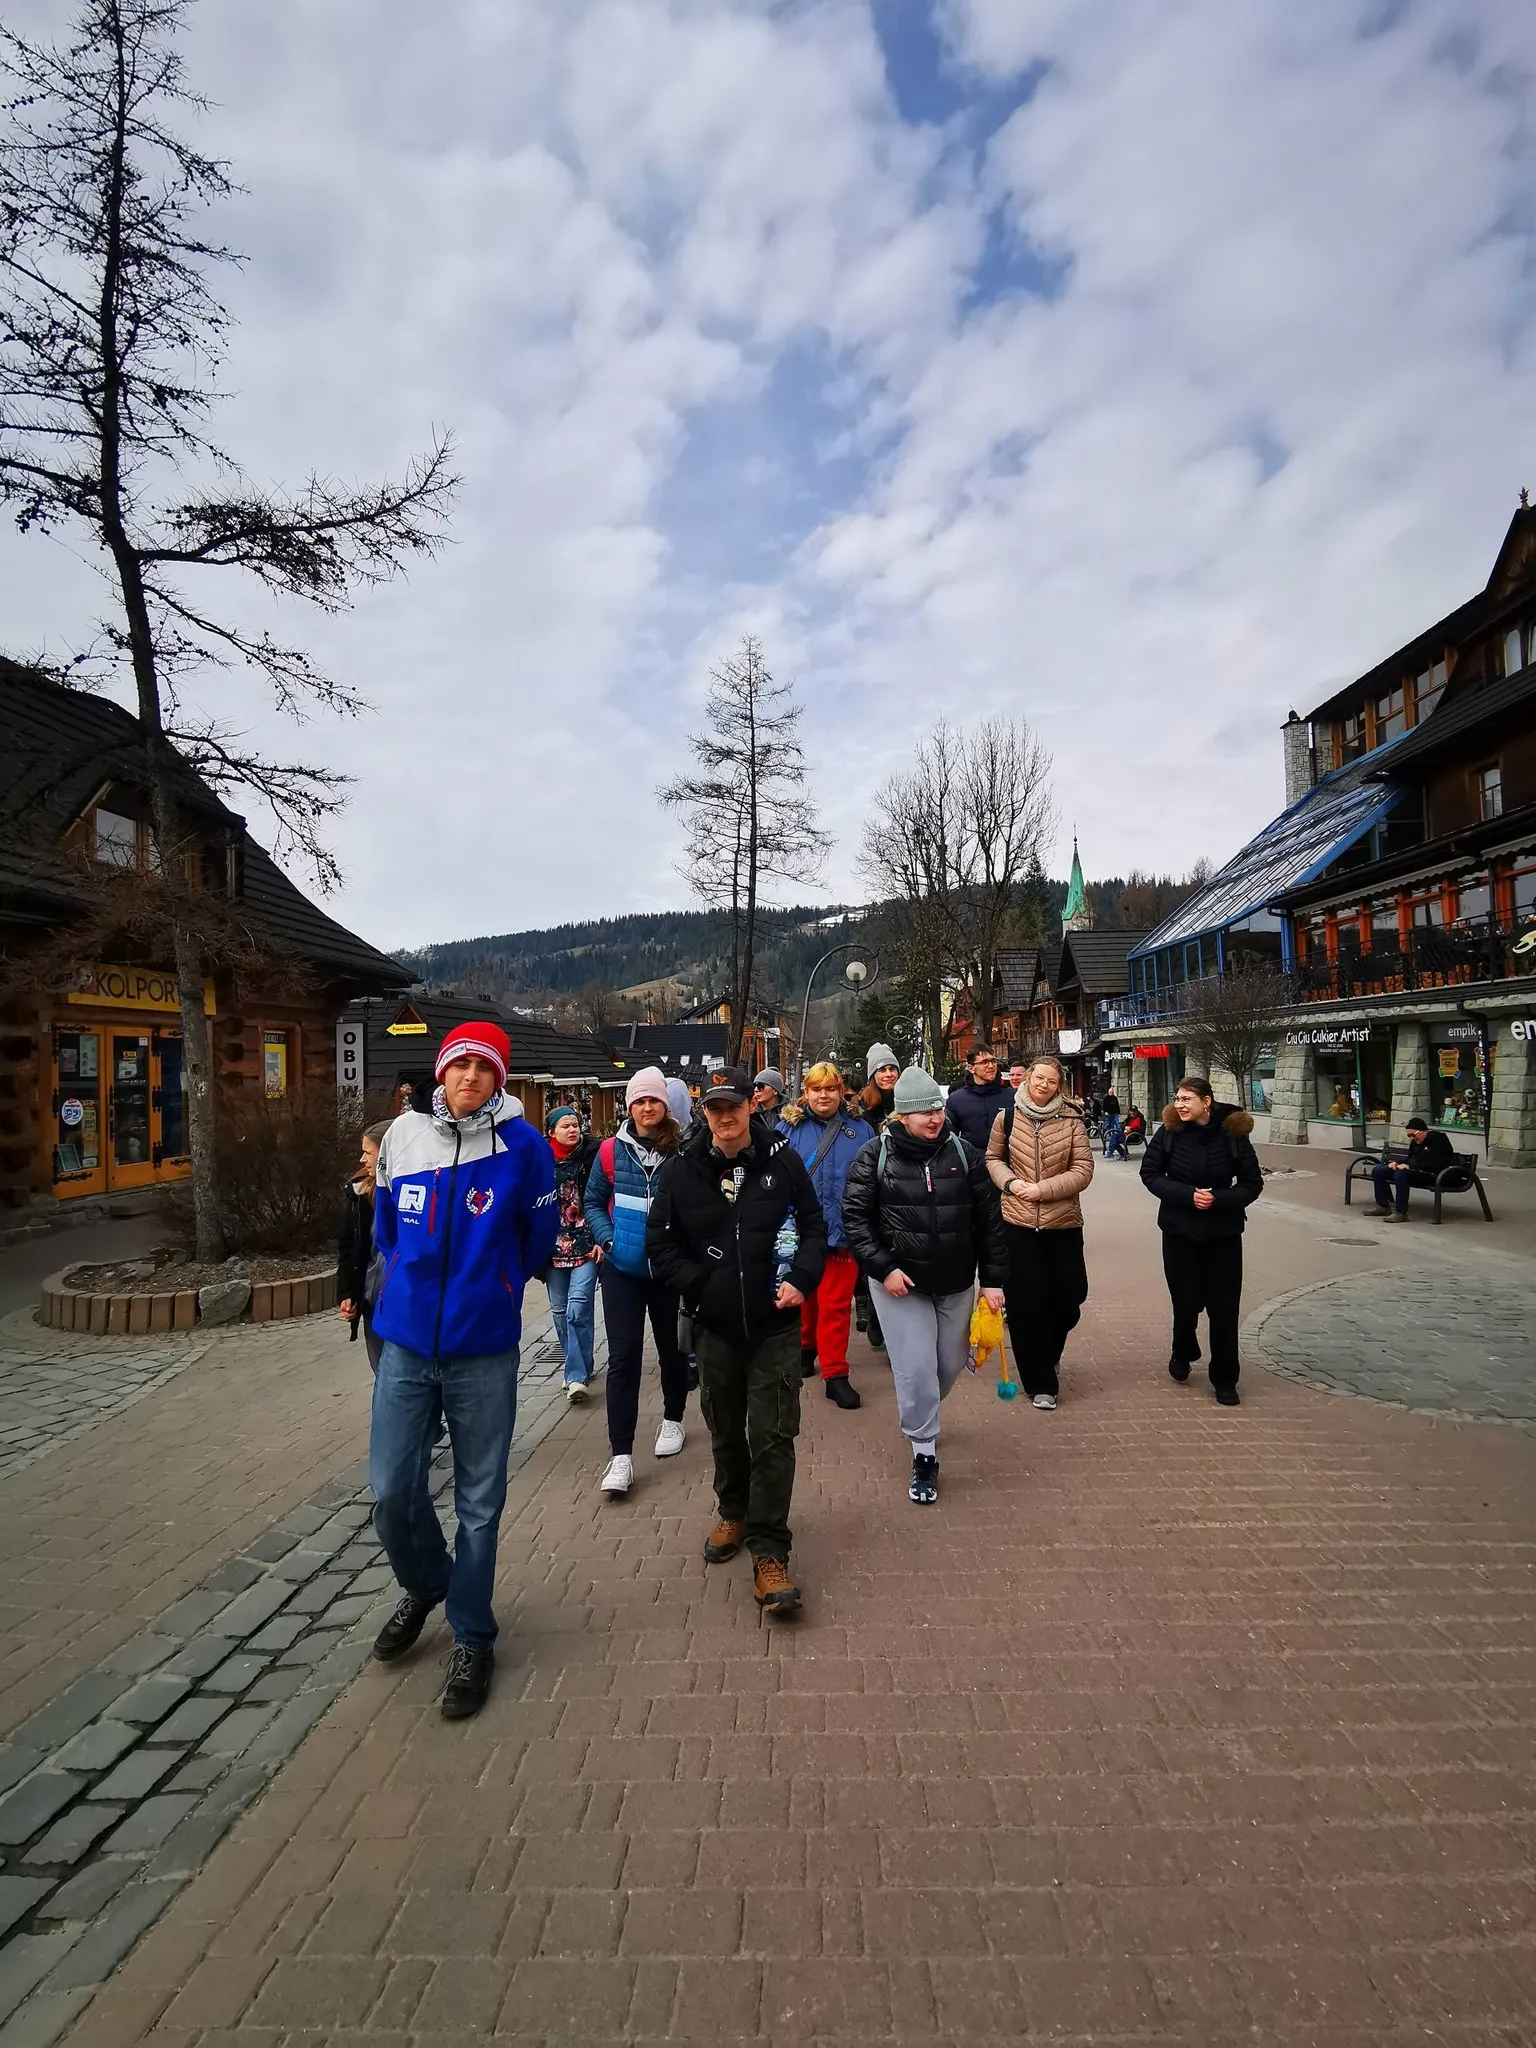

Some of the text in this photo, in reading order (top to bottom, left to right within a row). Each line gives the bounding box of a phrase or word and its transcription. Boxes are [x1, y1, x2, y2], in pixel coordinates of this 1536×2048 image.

[96, 971, 206, 1007] KOLPOR
[1286, 1028, 1370, 1045] Ciu Ciu Cukier Artist
[1448, 1023, 1476, 1038] empik
[1122, 1051, 1134, 1059] PRO
[765, 1176, 772, 1186] Y
